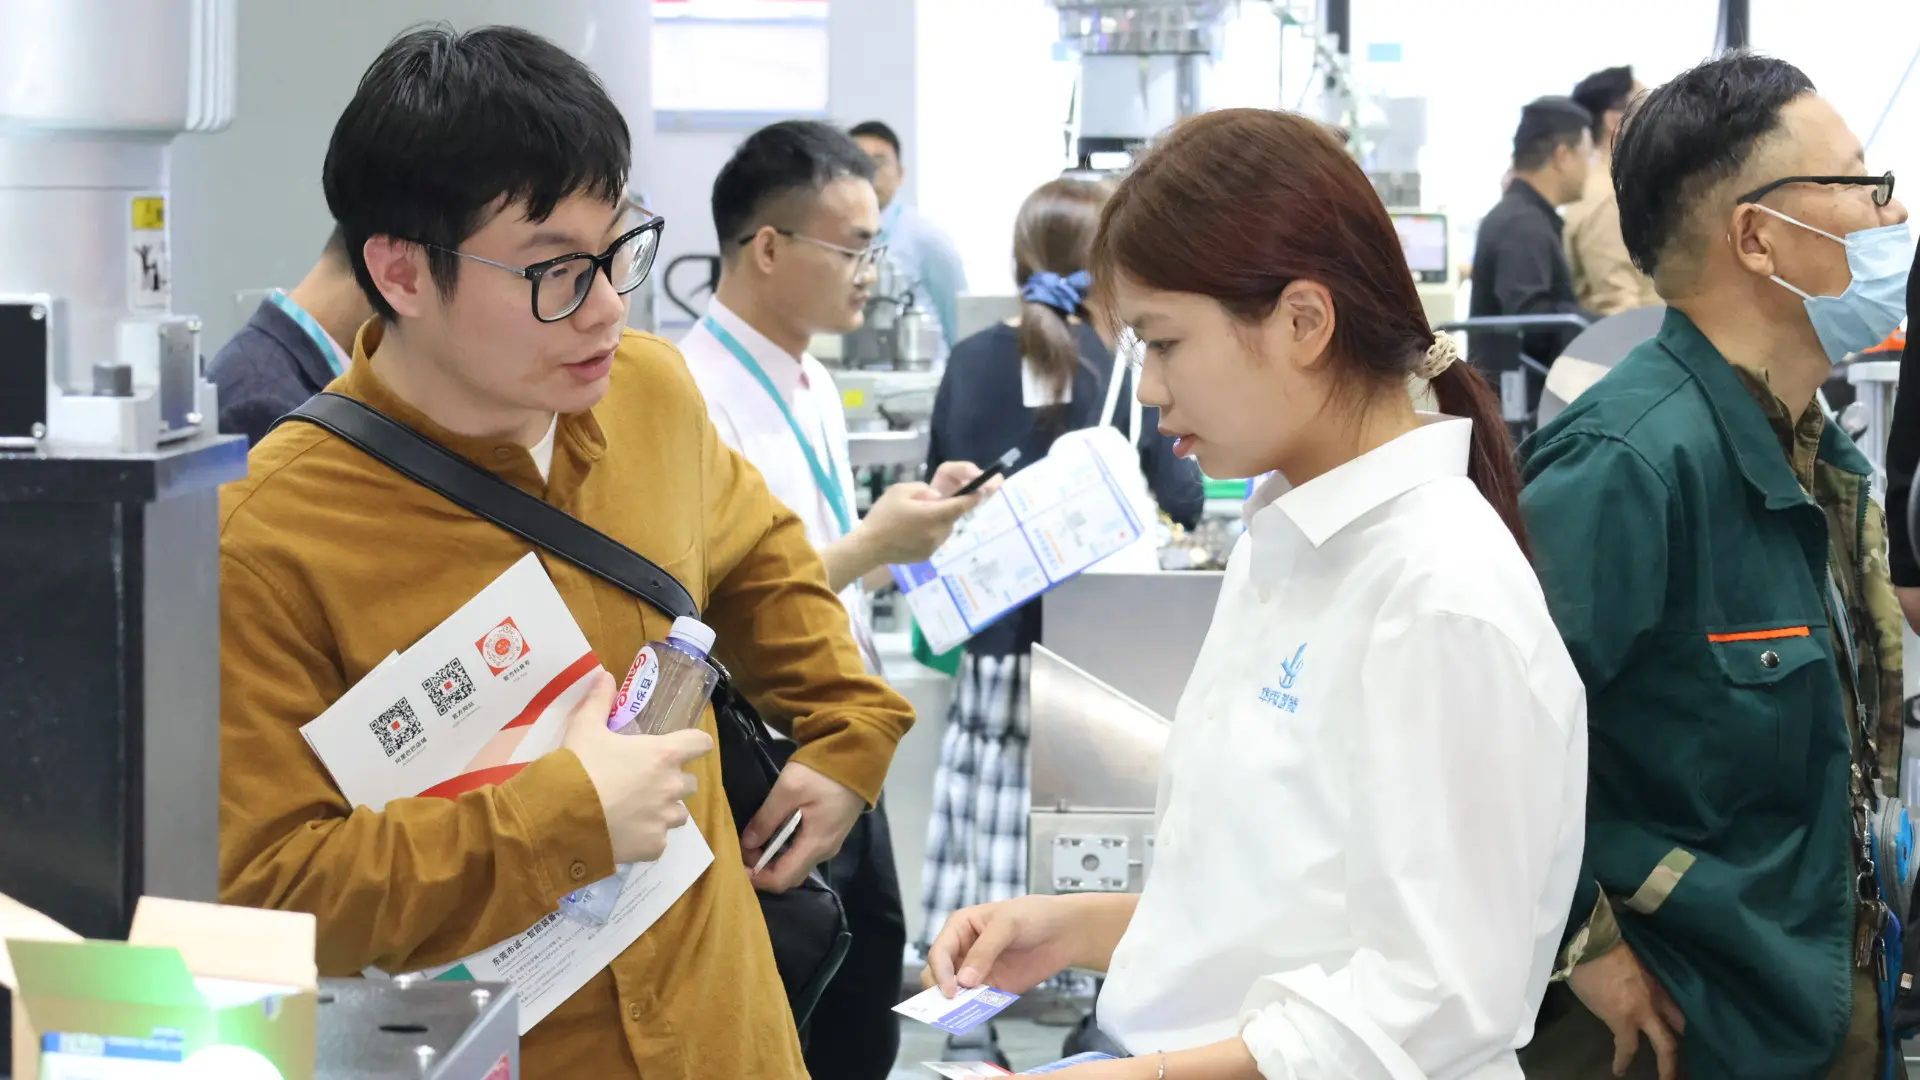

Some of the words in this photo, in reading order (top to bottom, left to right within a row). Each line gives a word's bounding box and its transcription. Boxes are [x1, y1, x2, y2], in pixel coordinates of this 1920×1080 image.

[630, 678, 652, 713] 百岁山
[452, 701, 475, 720] 官方网站
[395, 737, 428, 765] 阿里巴巴店铺
